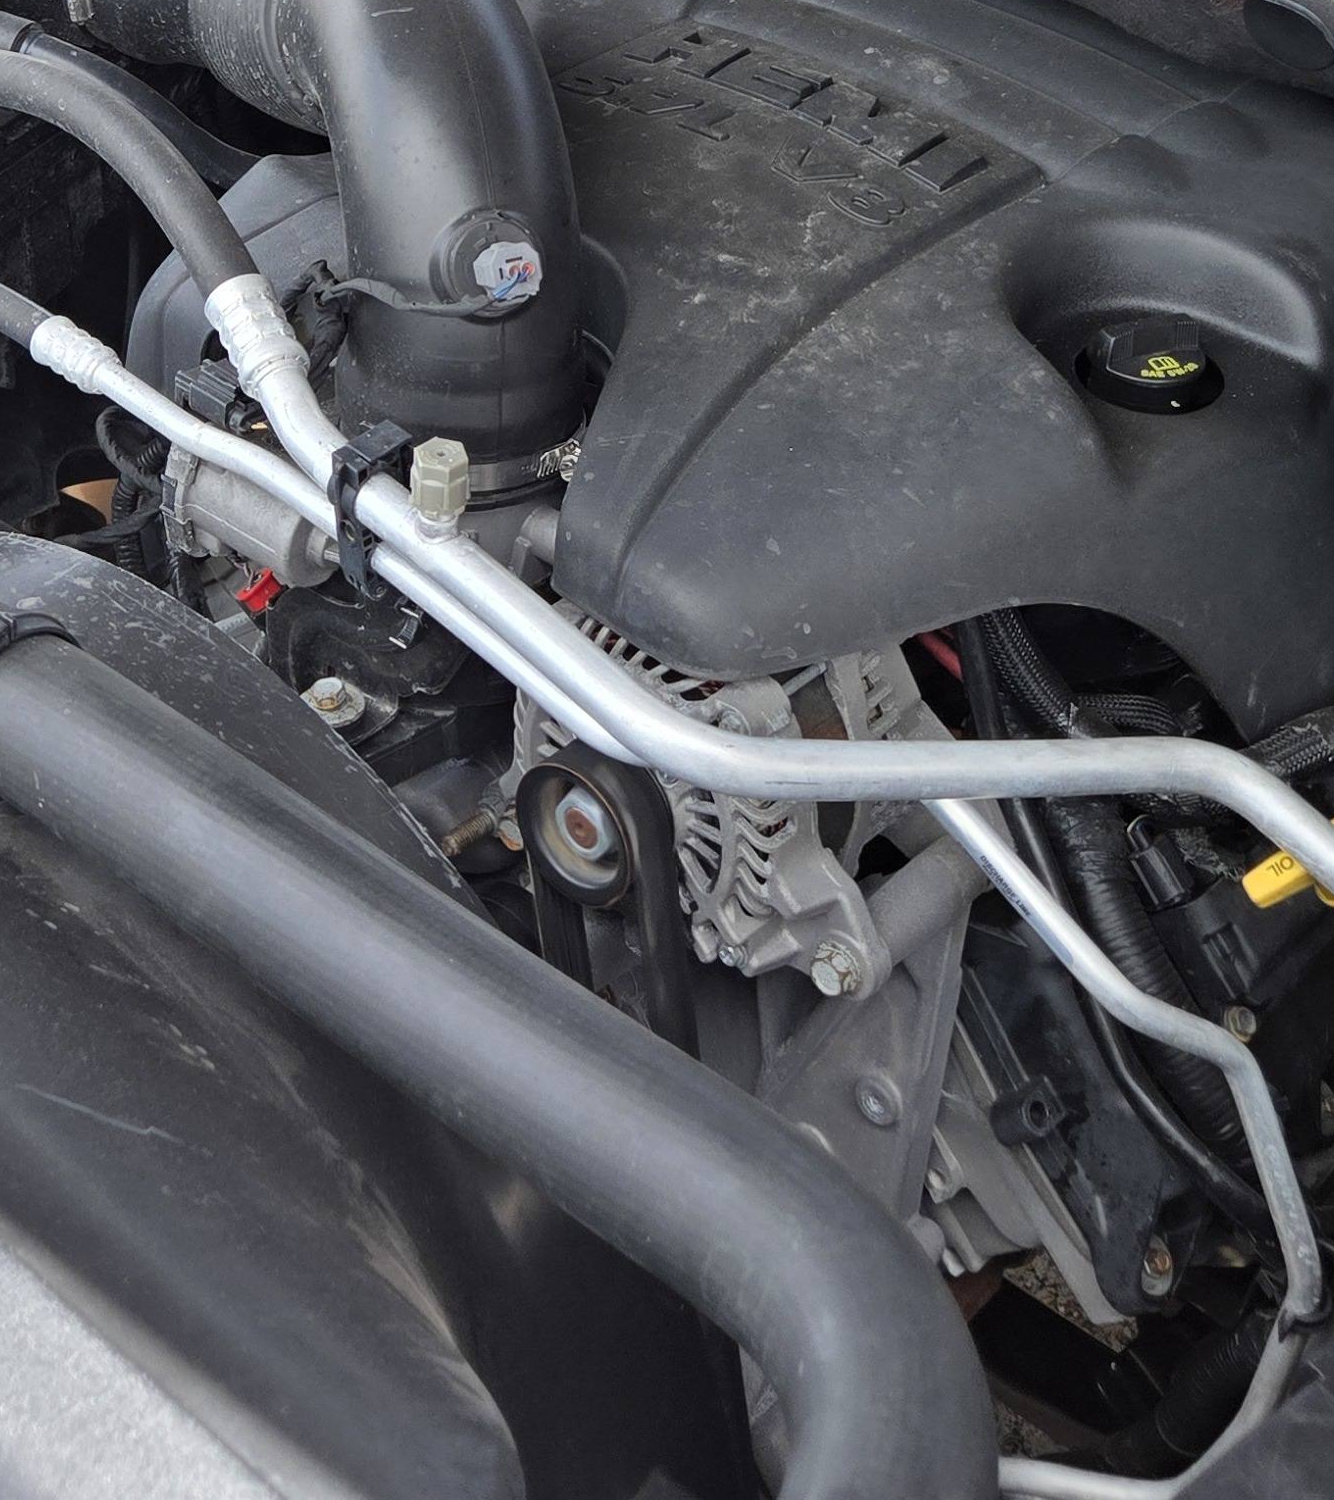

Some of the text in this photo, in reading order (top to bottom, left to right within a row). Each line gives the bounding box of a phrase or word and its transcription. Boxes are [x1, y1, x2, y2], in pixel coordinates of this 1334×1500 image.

[770, 136, 908, 227] V8
[1140, 368, 1165, 378] SAE
[978, 854, 1032, 917] DISCHARGE LINE
[1266, 856, 1294, 877] OIL
